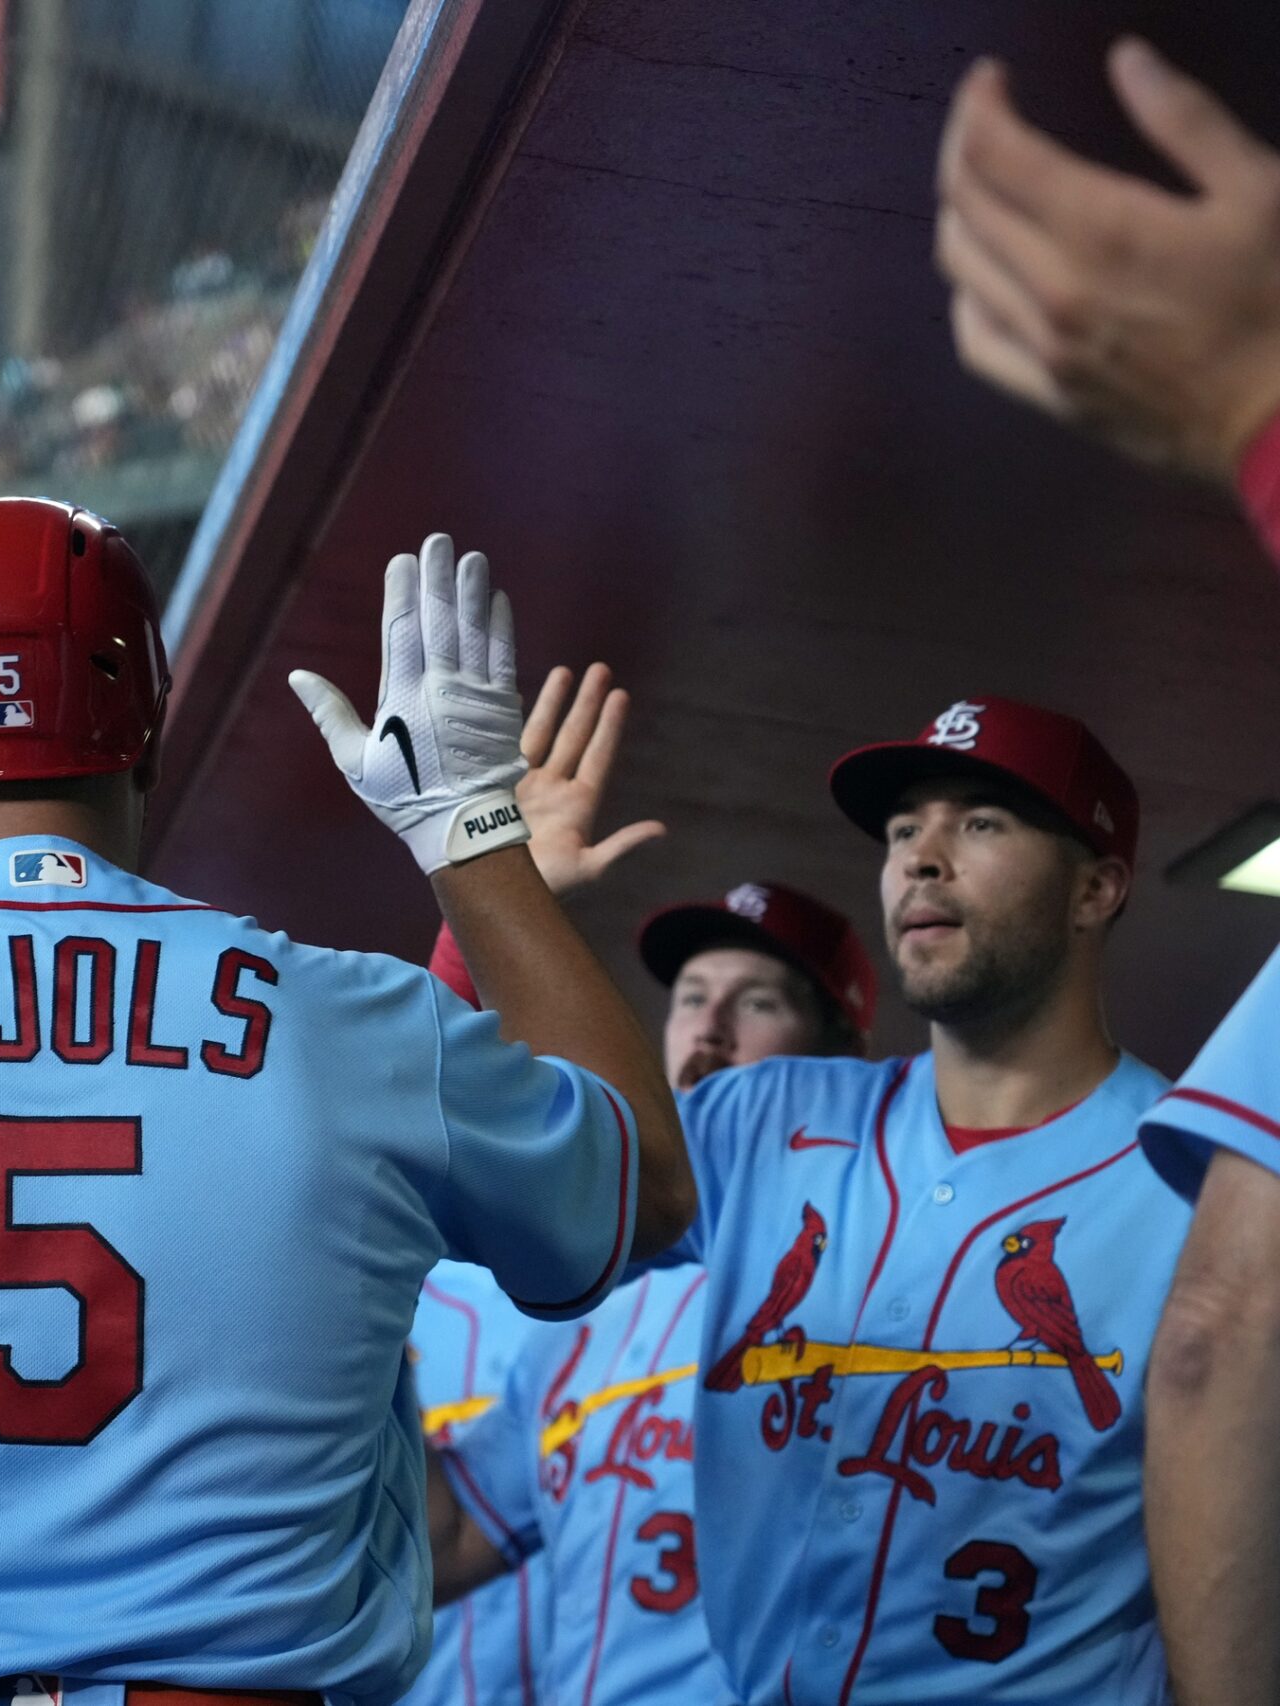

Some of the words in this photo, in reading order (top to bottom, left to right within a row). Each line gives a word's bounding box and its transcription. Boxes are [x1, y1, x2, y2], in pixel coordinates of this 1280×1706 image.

[583, 1379, 696, 1490] Lou
[761, 1324, 835, 1452] St.
[837, 1364, 1064, 1508] Louis
[932, 1539, 1039, 1664] 3
